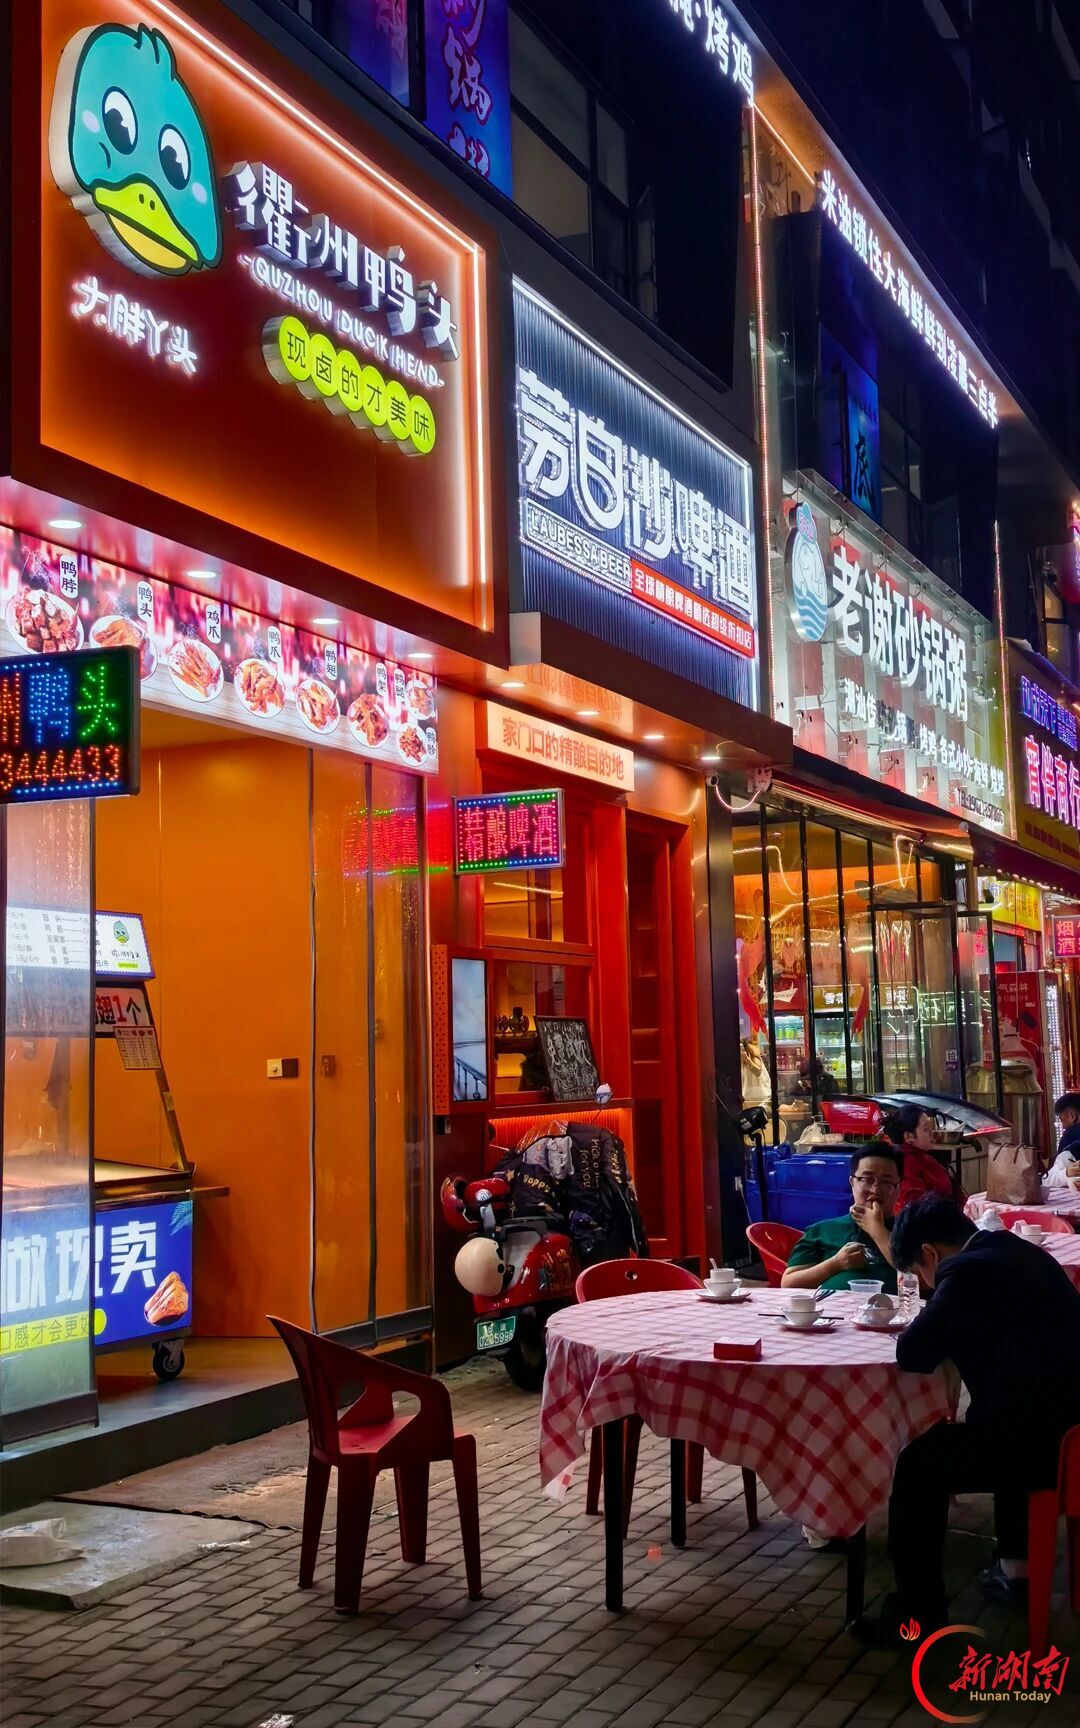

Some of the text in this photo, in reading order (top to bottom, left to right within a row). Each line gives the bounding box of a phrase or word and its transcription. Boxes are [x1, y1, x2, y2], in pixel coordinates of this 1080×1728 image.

[228, 161, 458, 358] 衢州鸭头
[337, 311, 389, 361] DUCK
[287, 331, 431, 441] 现卤的才美味
[61, 560, 78, 594] 鸭脖
[138, 586, 153, 617] 鸭头
[207, 609, 220, 639] 鸡爪
[268, 630, 281, 658] 鸭爪
[832, 545, 968, 722] 老谢砂锅粥
[502, 716, 624, 781] 家门口的精酿目的地
[463, 802, 557, 862] 精酿啤酒
[1, 1220, 157, 1315] 做现卖
